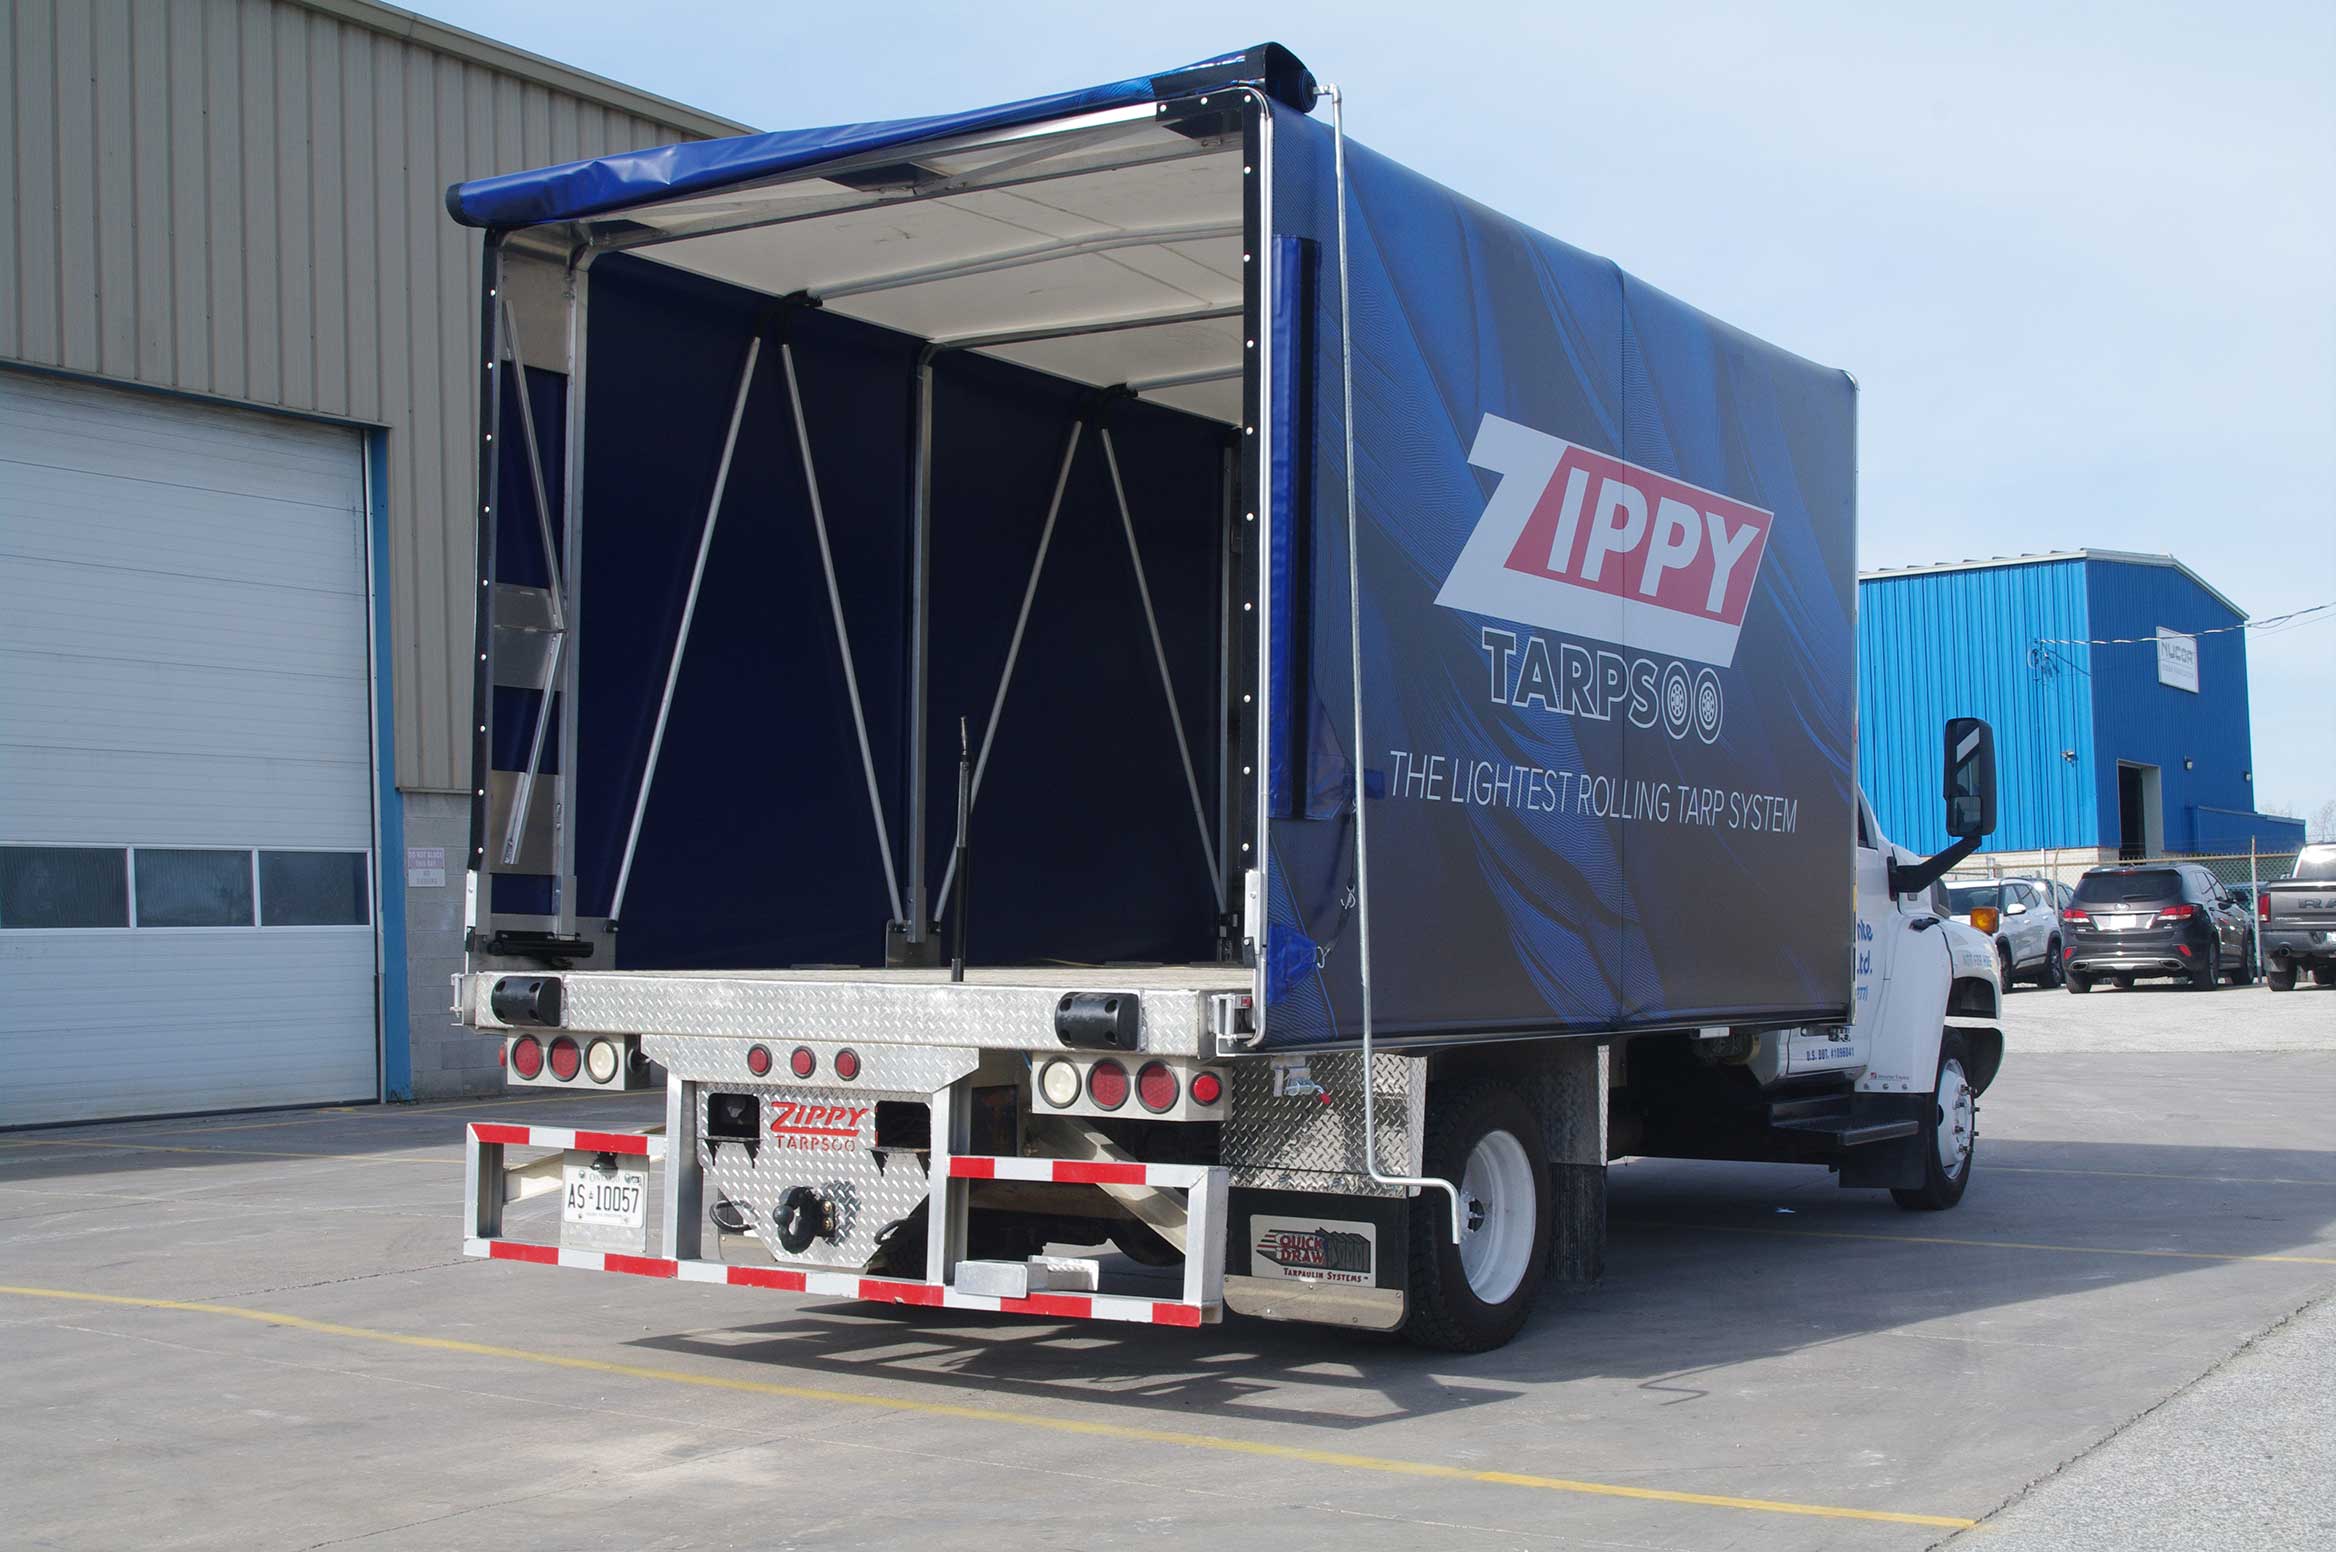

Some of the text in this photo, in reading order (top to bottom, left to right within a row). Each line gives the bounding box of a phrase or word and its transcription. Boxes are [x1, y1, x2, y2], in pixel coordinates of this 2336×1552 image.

[1433, 411, 1775, 668] ZIPPY
[1390, 750, 1798, 833] THE LIGHTEST ROLLING TARP SYSTEM
[770, 1101, 869, 1137] ZIPPY
[1279, 1235, 1323, 1250] QUICK
[1280, 1249, 1324, 1264] DRAW
[1283, 1267, 1362, 1283] TARPAULIN SYSTEMS
